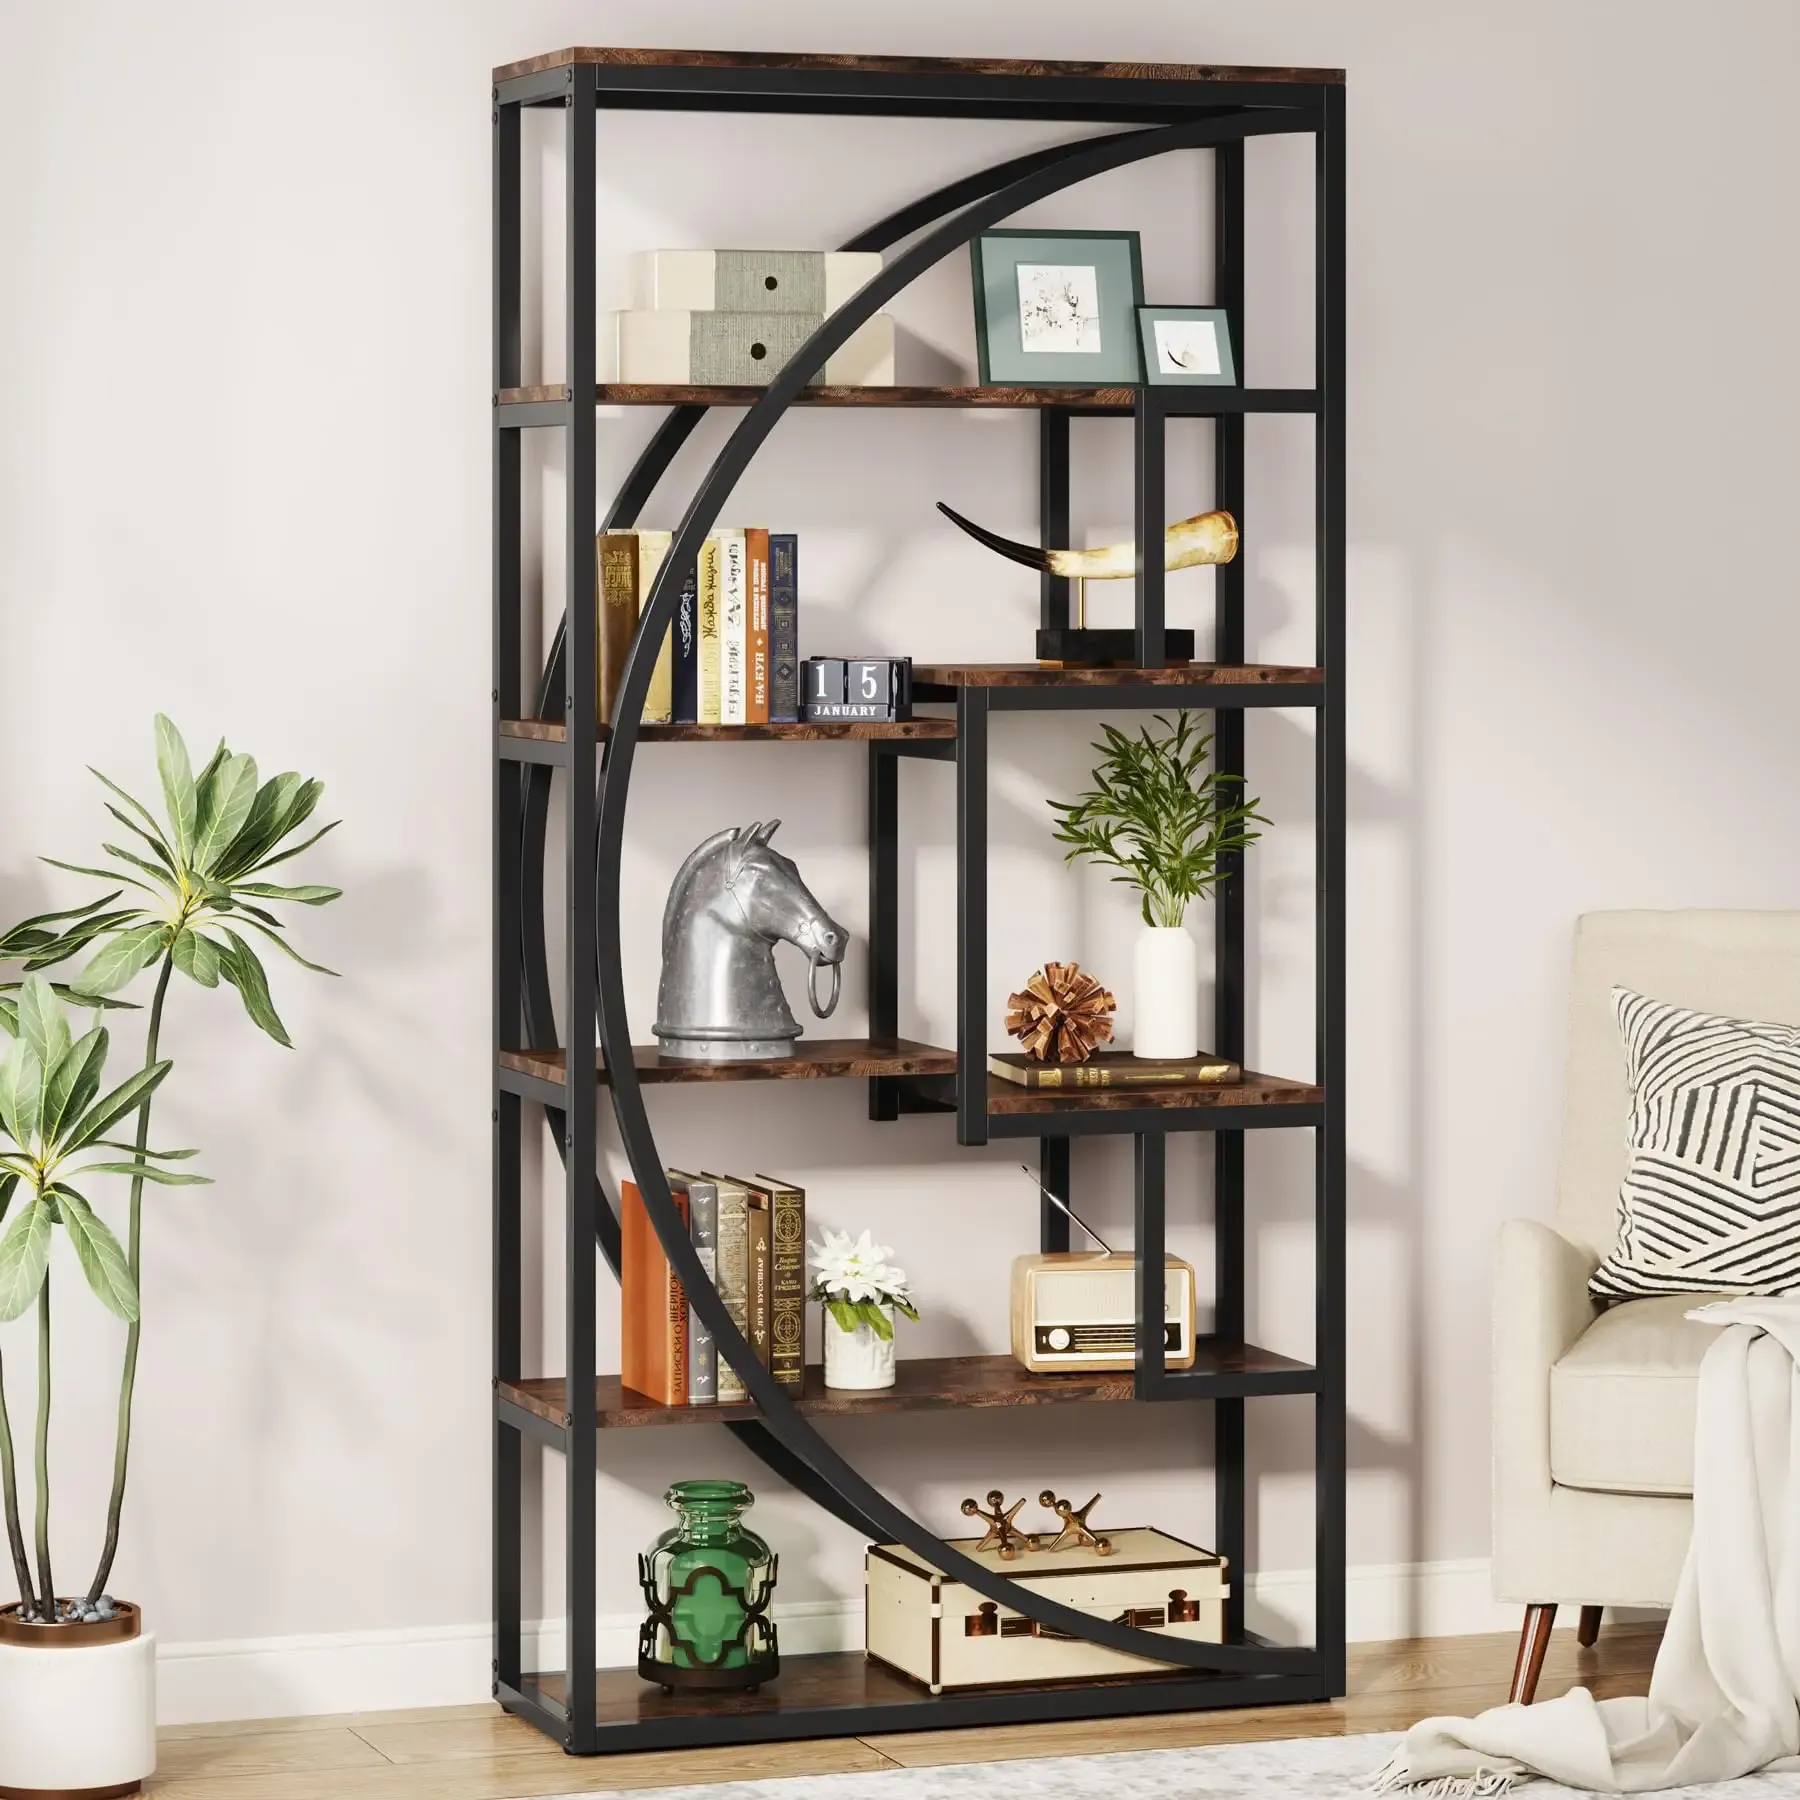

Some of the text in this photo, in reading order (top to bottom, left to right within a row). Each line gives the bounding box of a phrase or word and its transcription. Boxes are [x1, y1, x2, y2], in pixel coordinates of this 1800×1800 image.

[704, 547, 718, 590] жизни
[702, 593, 718, 639] Жажда
[816, 664, 878, 699] 1 5
[814, 706, 877, 717] JANUARY
[673, 1337, 683, 1395] ЗАПИСКИ
